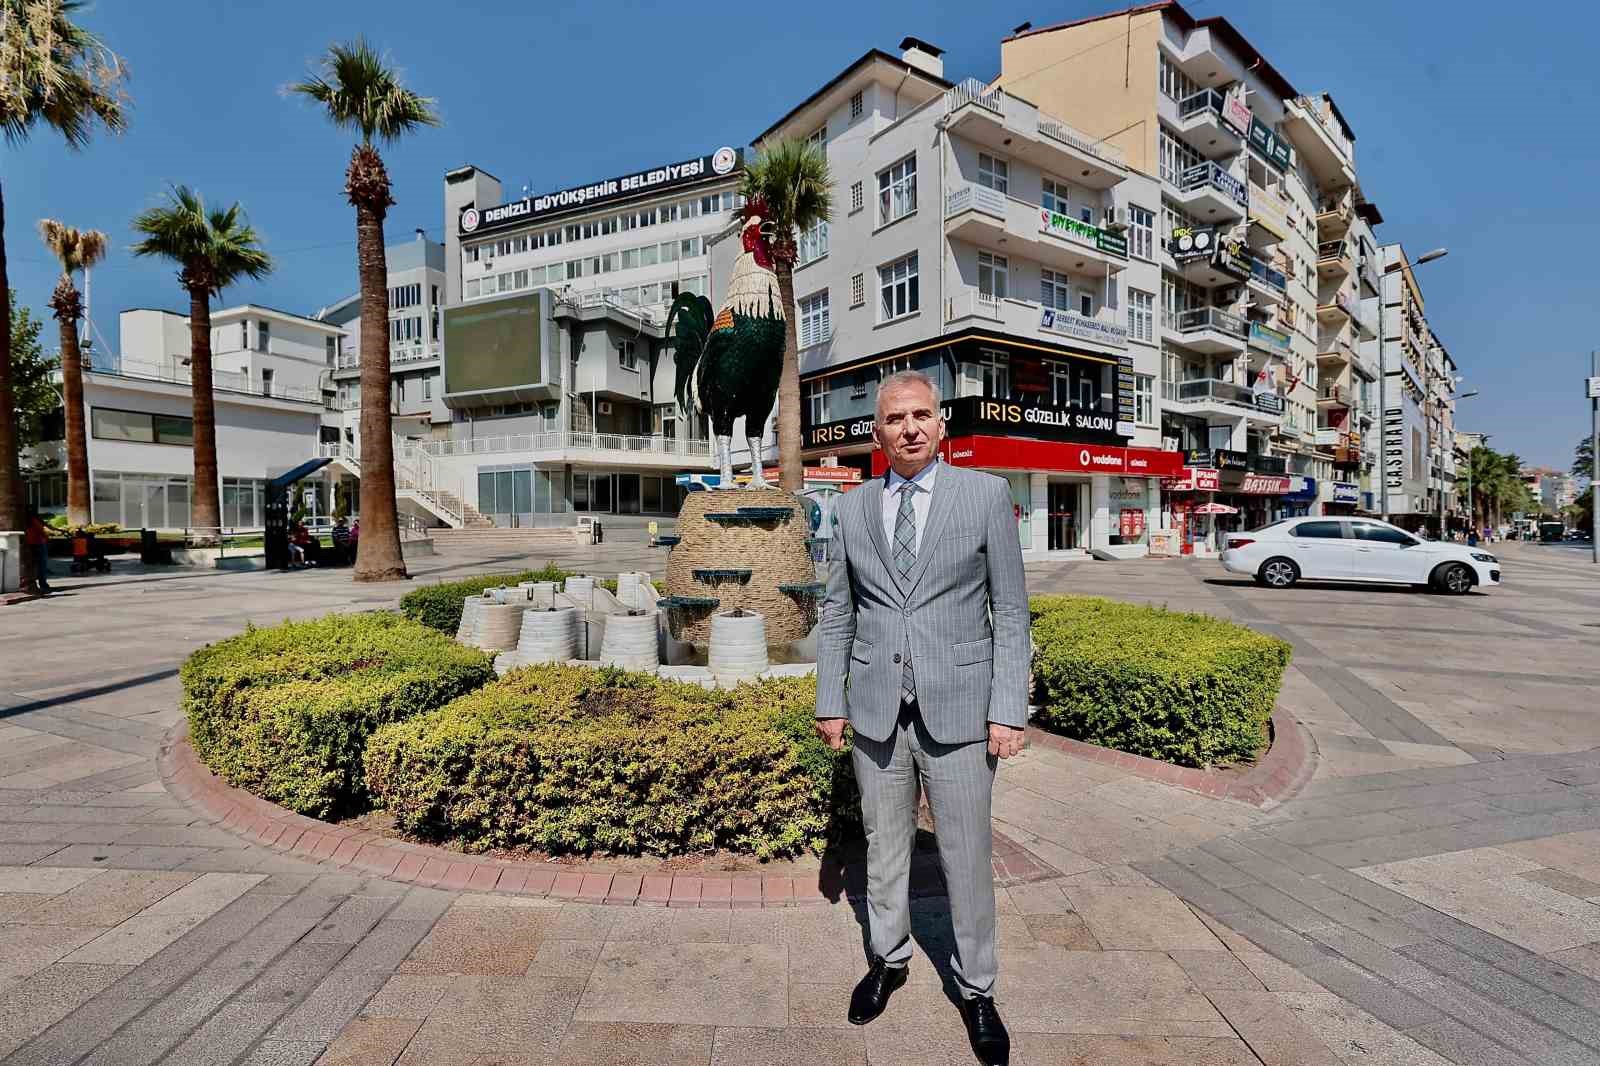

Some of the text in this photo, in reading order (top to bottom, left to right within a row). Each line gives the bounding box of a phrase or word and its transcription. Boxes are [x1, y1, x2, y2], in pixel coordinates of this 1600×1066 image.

[485, 158, 705, 223] DENİZLİ BÜYÜKŞEHİR BELEDİYESİ
[980, 401, 1022, 423] IRIS
[1024, 408, 1071, 427] GÜZELLİK
[1075, 415, 1113, 431] SALONU
[812, 425, 846, 444] IRIS
[1092, 454, 1122, 466] vodafone
